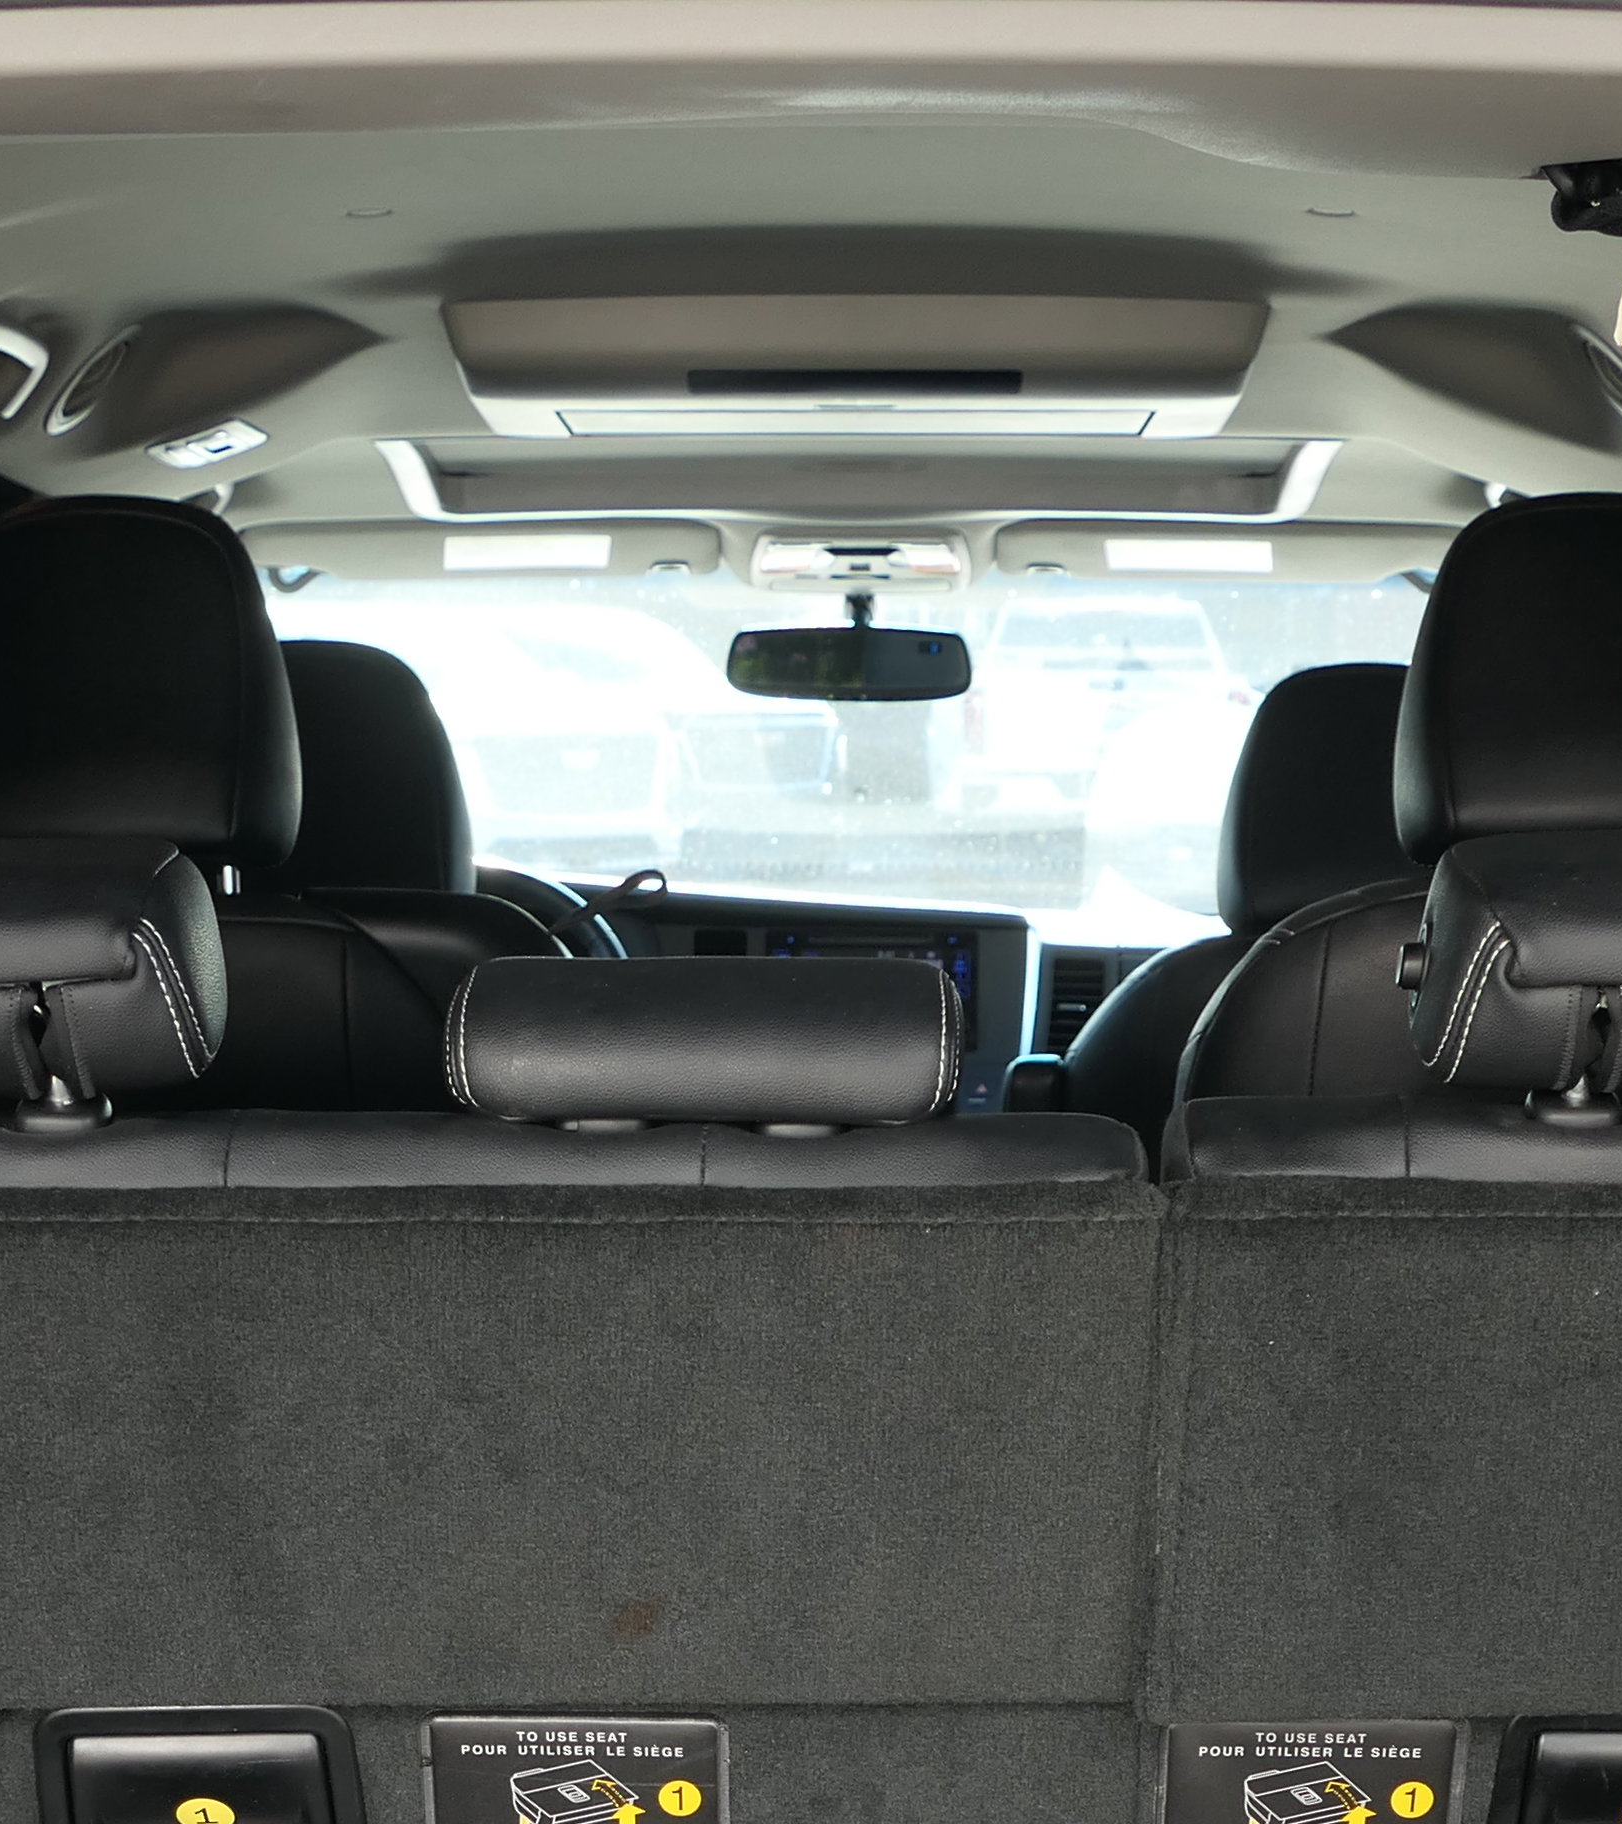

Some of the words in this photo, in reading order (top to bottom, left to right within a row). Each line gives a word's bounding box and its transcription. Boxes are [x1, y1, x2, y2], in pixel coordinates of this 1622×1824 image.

[516, 1731, 538, 1742] TO
[545, 1731, 578, 1743] USE
[585, 1732, 628, 1743] SEAT
[1256, 1732, 1277, 1743] TO
[1284, 1733, 1317, 1743] USE
[1324, 1733, 1367, 1743] SEAT
[461, 1745, 507, 1755] POUR
[518, 1745, 595, 1756] UTILISER
[606, 1746, 626, 1757] LE
[633, 1744, 684, 1757] SIÈGE
[1199, 1746, 1244, 1757] POUR
[1255, 1746, 1333, 1758] UTILISER
[1343, 1747, 1363, 1758] LE
[1370, 1745, 1422, 1758] SIÈGE
[671, 1786, 684, 1811] 1
[1404, 1788, 1416, 1812] 1
[194, 1808, 219, 1824] 1
